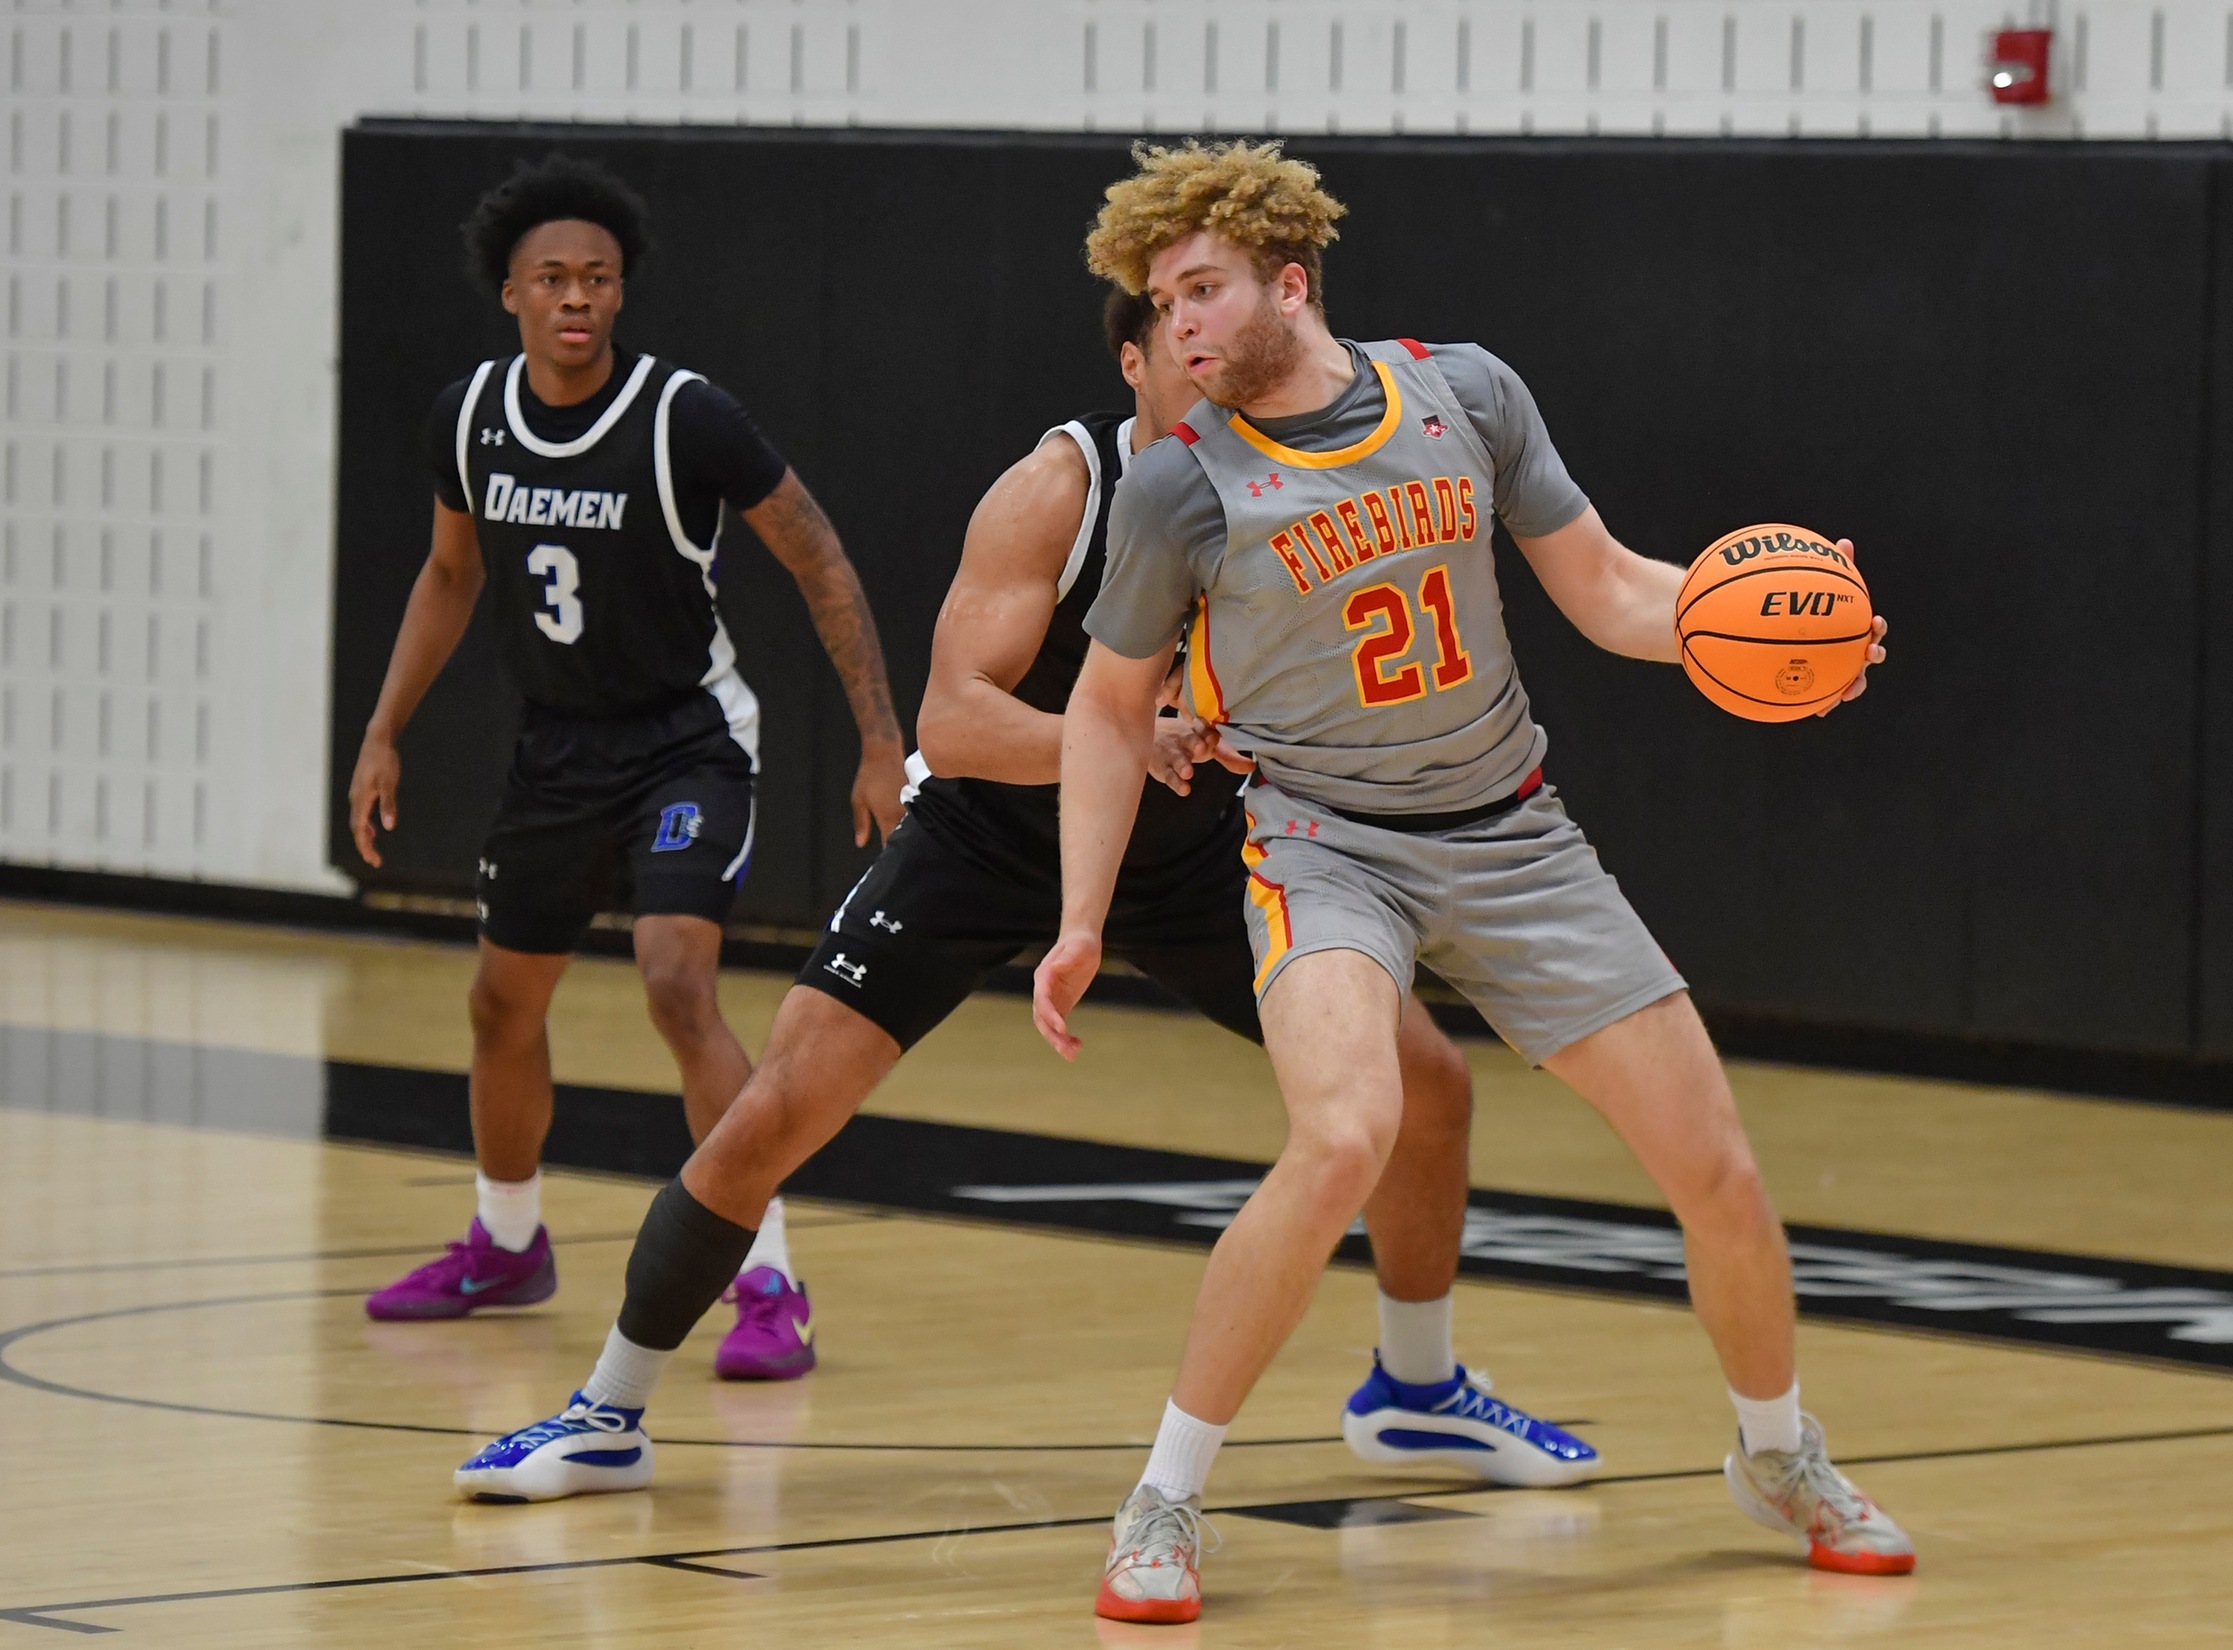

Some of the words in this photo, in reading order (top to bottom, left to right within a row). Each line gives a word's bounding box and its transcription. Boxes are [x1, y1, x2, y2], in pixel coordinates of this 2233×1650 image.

[1268, 476, 1477, 596] FIREBIRDS
[1719, 533, 1853, 573] Wilson
[526, 543, 584, 645] 3
[1341, 564, 1473, 708] 21
[1760, 591, 1836, 617] EVO
